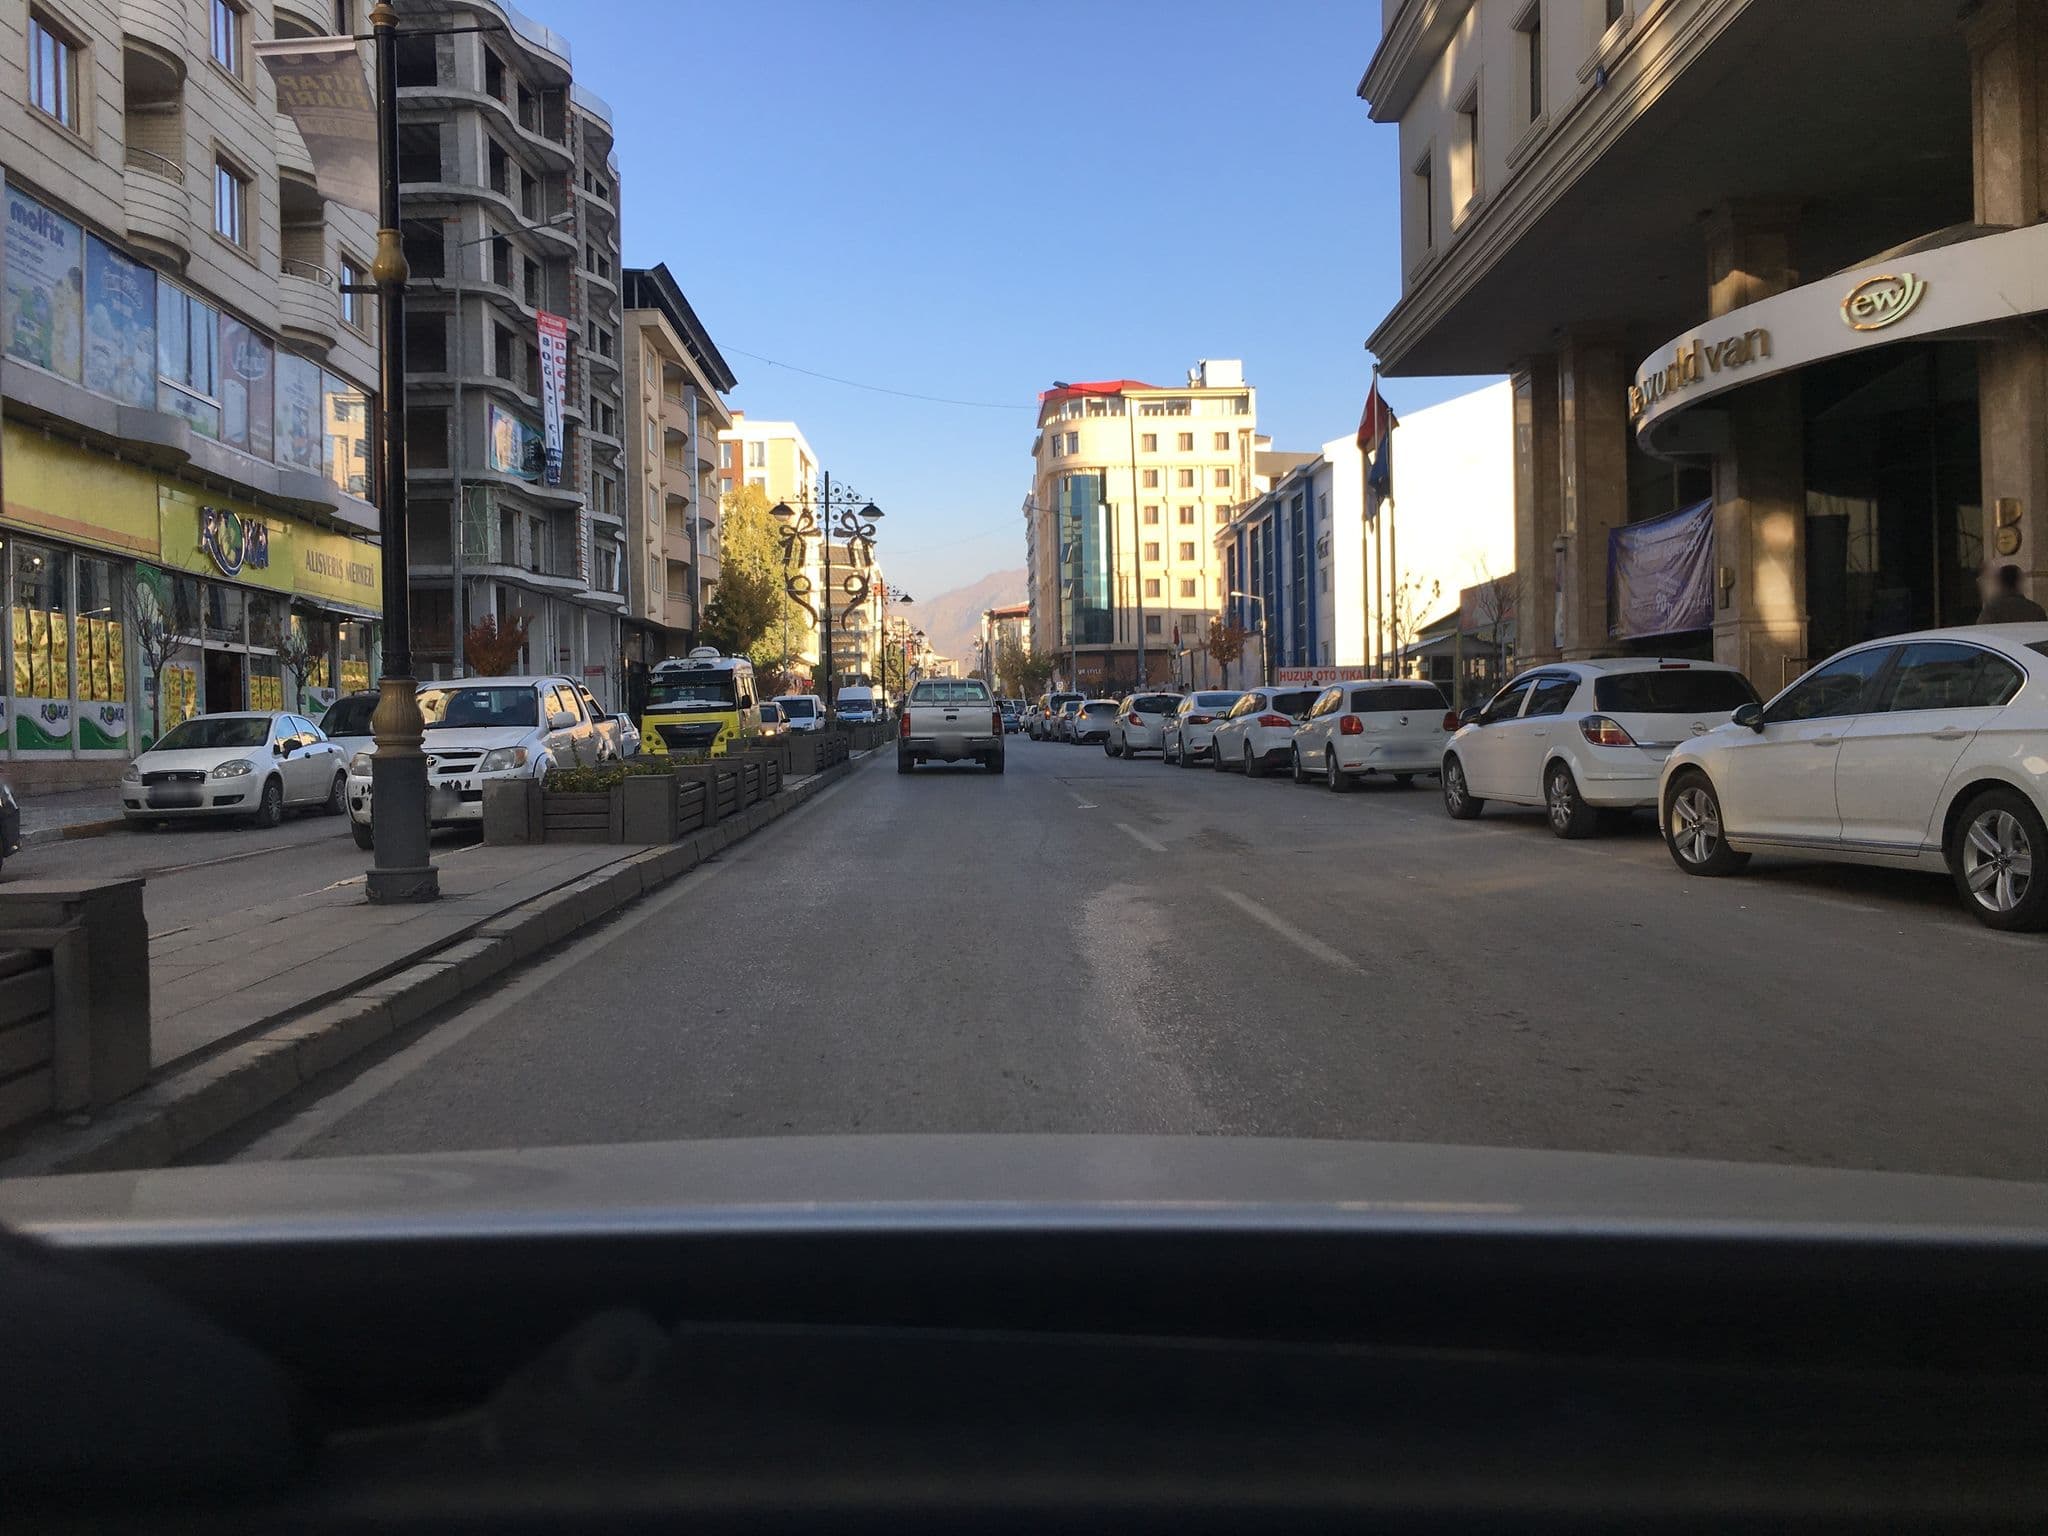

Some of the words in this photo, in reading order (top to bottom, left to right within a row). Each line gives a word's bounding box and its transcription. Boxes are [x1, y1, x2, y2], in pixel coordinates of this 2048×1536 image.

[10, 201, 65, 247] molfix
[305, 549, 343, 584] ALIŞVERİŞ
[345, 562, 375, 588] MERKEZİ
[1279, 670, 1313, 681] HUZUR
[1316, 670, 1336, 681] OTO
[1340, 670, 1378, 681] YIKAA
[41, 703, 69, 723] ROKA
[100, 706, 125, 726] ROKA
